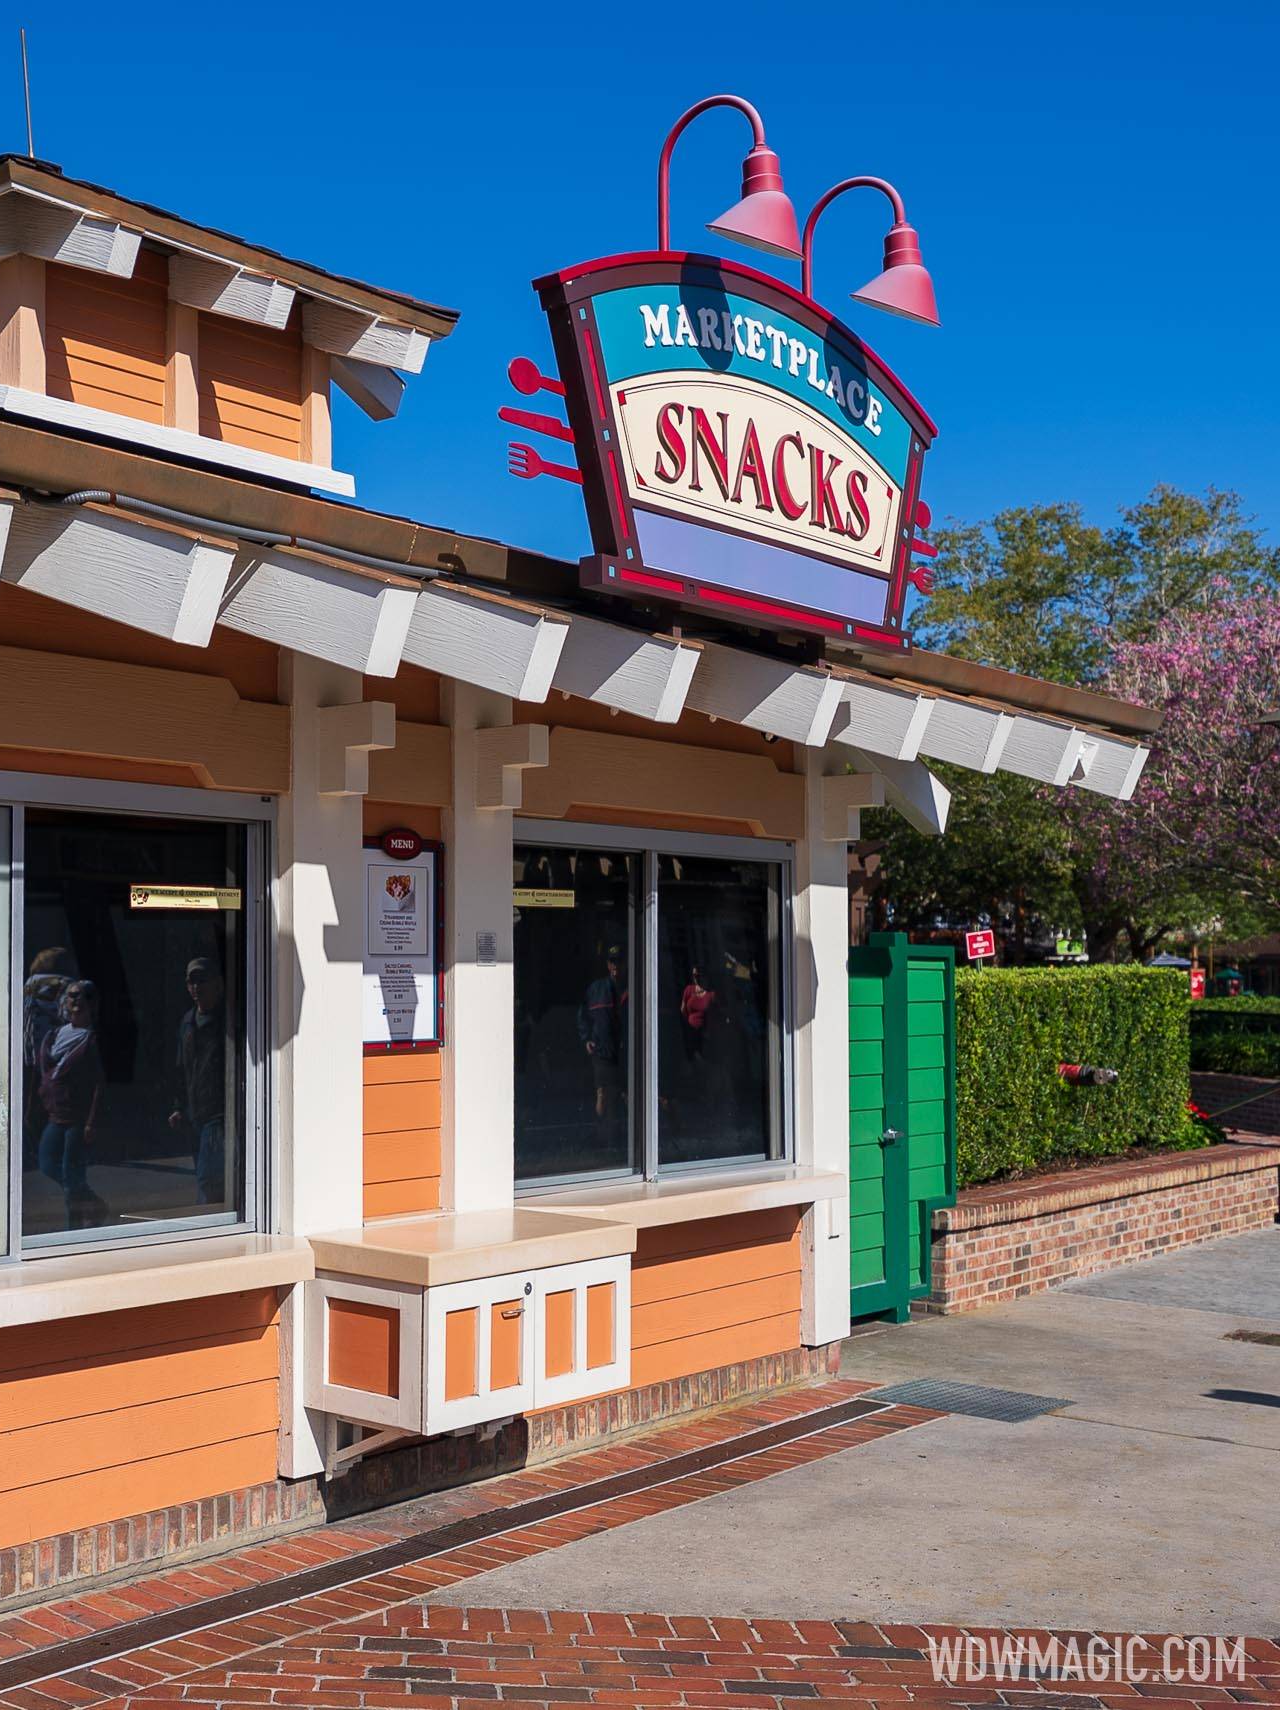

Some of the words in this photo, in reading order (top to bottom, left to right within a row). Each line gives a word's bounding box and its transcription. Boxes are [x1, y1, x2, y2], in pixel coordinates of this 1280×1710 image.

[639, 303, 884, 437] MARKETPLACE
[654, 402, 871, 542] SNACKS
[391, 839, 414, 849] MENU
